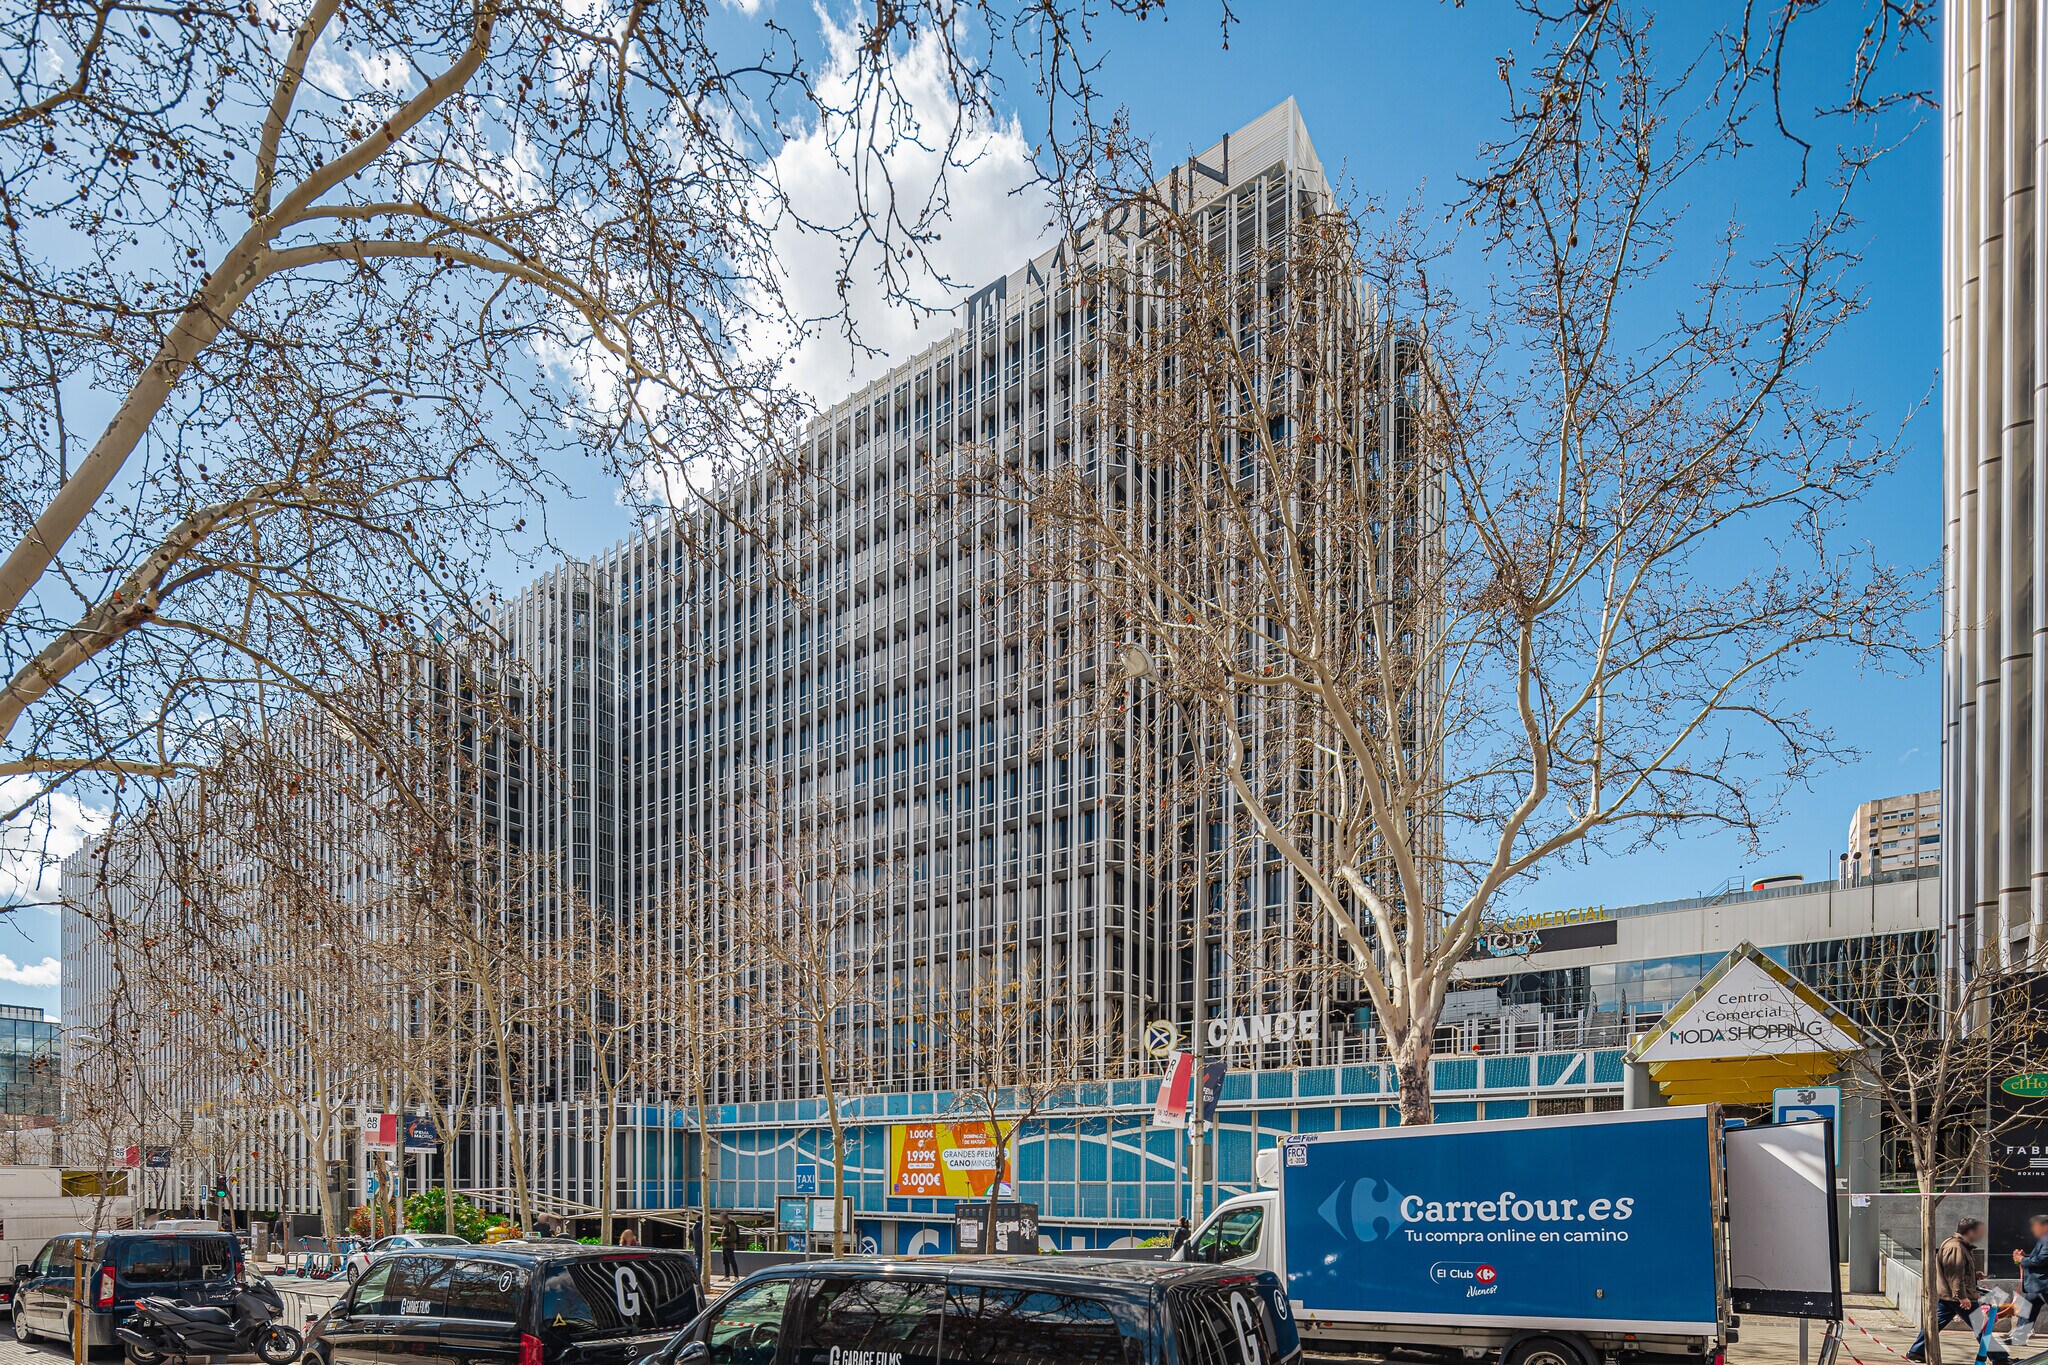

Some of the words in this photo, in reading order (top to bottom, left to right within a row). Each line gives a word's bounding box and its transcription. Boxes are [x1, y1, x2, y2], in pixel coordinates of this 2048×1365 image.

[1503, 904, 1609, 931] COMERCIAL
[1718, 993, 1769, 1005] Centro
[1705, 1006, 1782, 1022] Comercial
[1208, 1009, 1319, 1048] CANOE
[906, 1150, 936, 1162] 1.999€
[943, 1150, 976, 1159] GRANDES
[976, 1149, 1008, 1159] PREMS
[1288, 1148, 1306, 1157] FRCX
[796, 1174, 815, 1184] TAXI
[902, 1172, 940, 1186] 3.000€
[1399, 1191, 1635, 1223] Carrefour.es
[1404, 1229, 1423, 1242] Tu
[1425, 1230, 1484, 1245] compra
[1487, 1228, 1536, 1242] online
[1539, 1230, 1560, 1242] en
[1563, 1227, 1629, 1242] camino
[1437, 1268, 1446, 1279] El
[1450, 1268, 1474, 1279] Club
[614, 1266, 641, 1317] G
[407, 1301, 419, 1313] GARAGE
[419, 1301, 431, 1314] FILMS
[1230, 1291, 1262, 1365] G
[842, 1350, 875, 1365] GARAGE
[877, 1351, 902, 1365] FILMS
